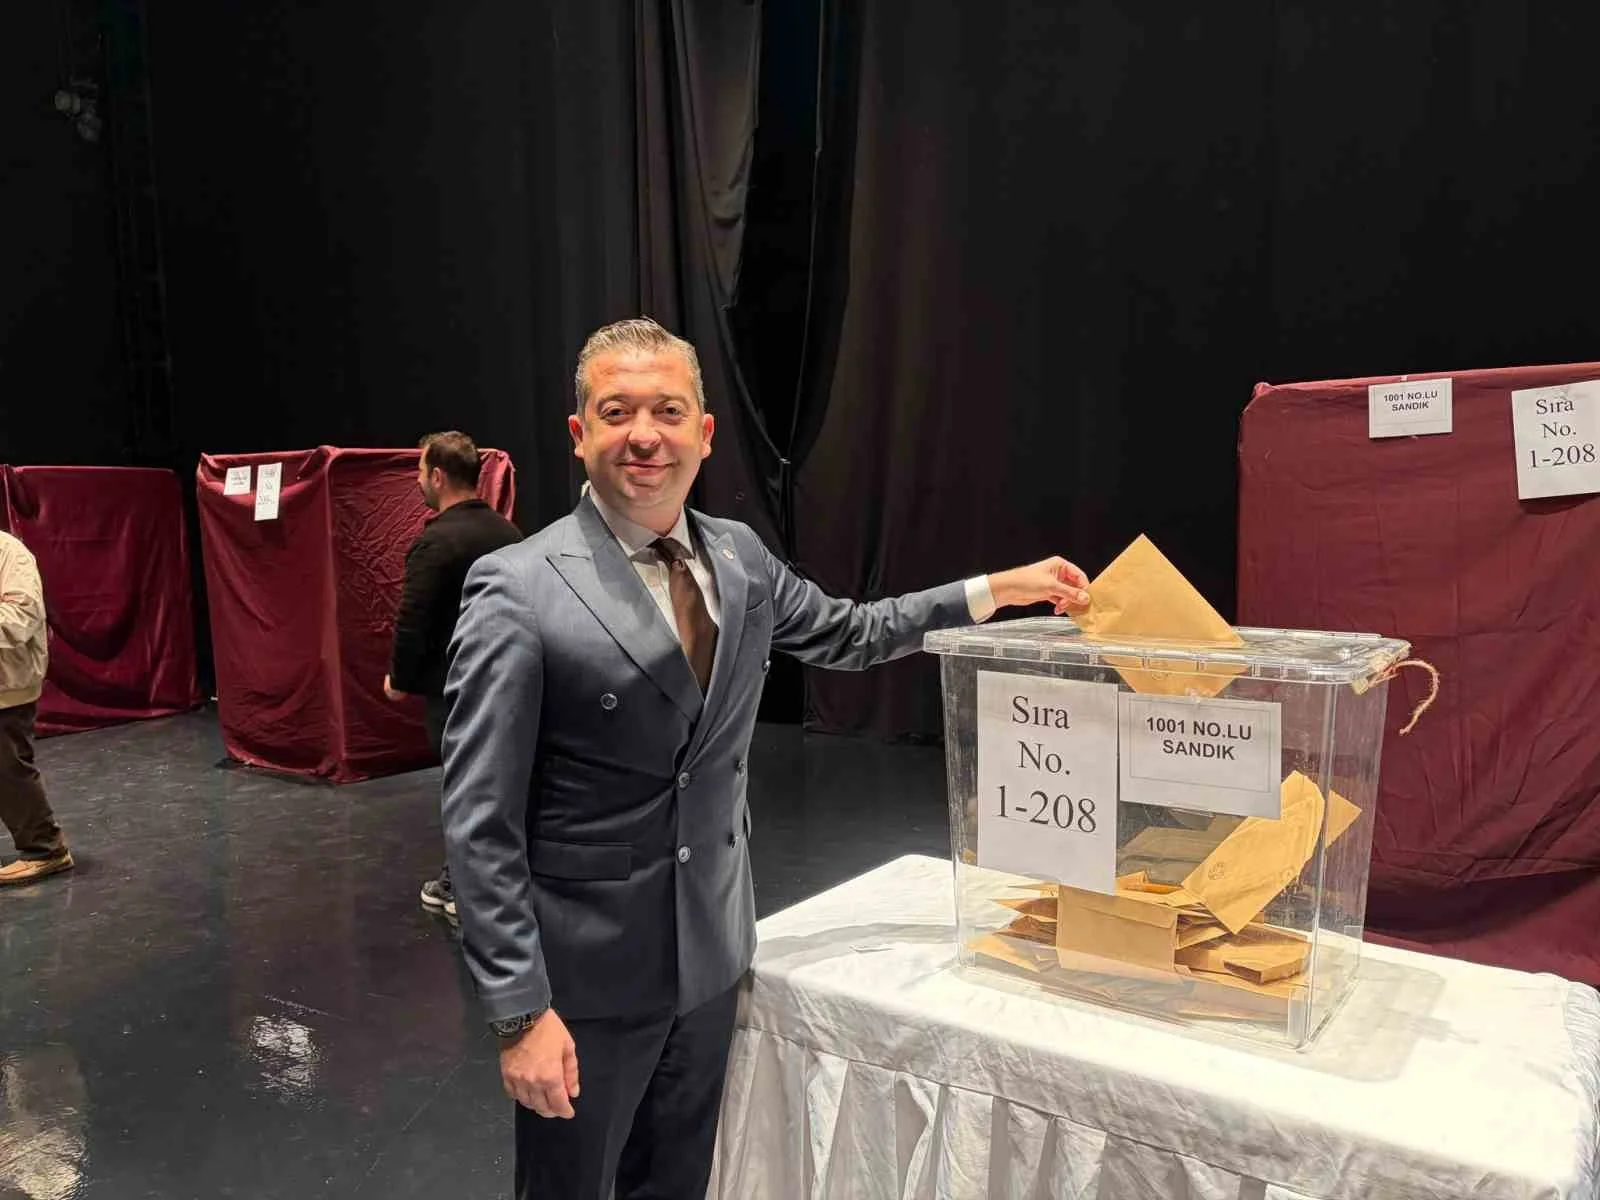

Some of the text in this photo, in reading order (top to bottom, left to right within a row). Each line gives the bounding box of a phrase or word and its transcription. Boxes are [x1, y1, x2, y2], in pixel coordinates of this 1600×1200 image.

[1383, 390, 1438, 402] 1001 NO.LU
[1391, 401, 1430, 412] SANDIK
[1535, 398, 1575, 415] Sıra
[1542, 422, 1577, 438] No.
[1528, 443, 1596, 469] 1-208
[1012, 695, 1070, 730] Sıra
[1146, 717, 1252, 740] 1001 NO.LU
[1017, 741, 1071, 776] No.
[1162, 739, 1236, 761] SANDIK
[995, 784, 1097, 833] 1-208
